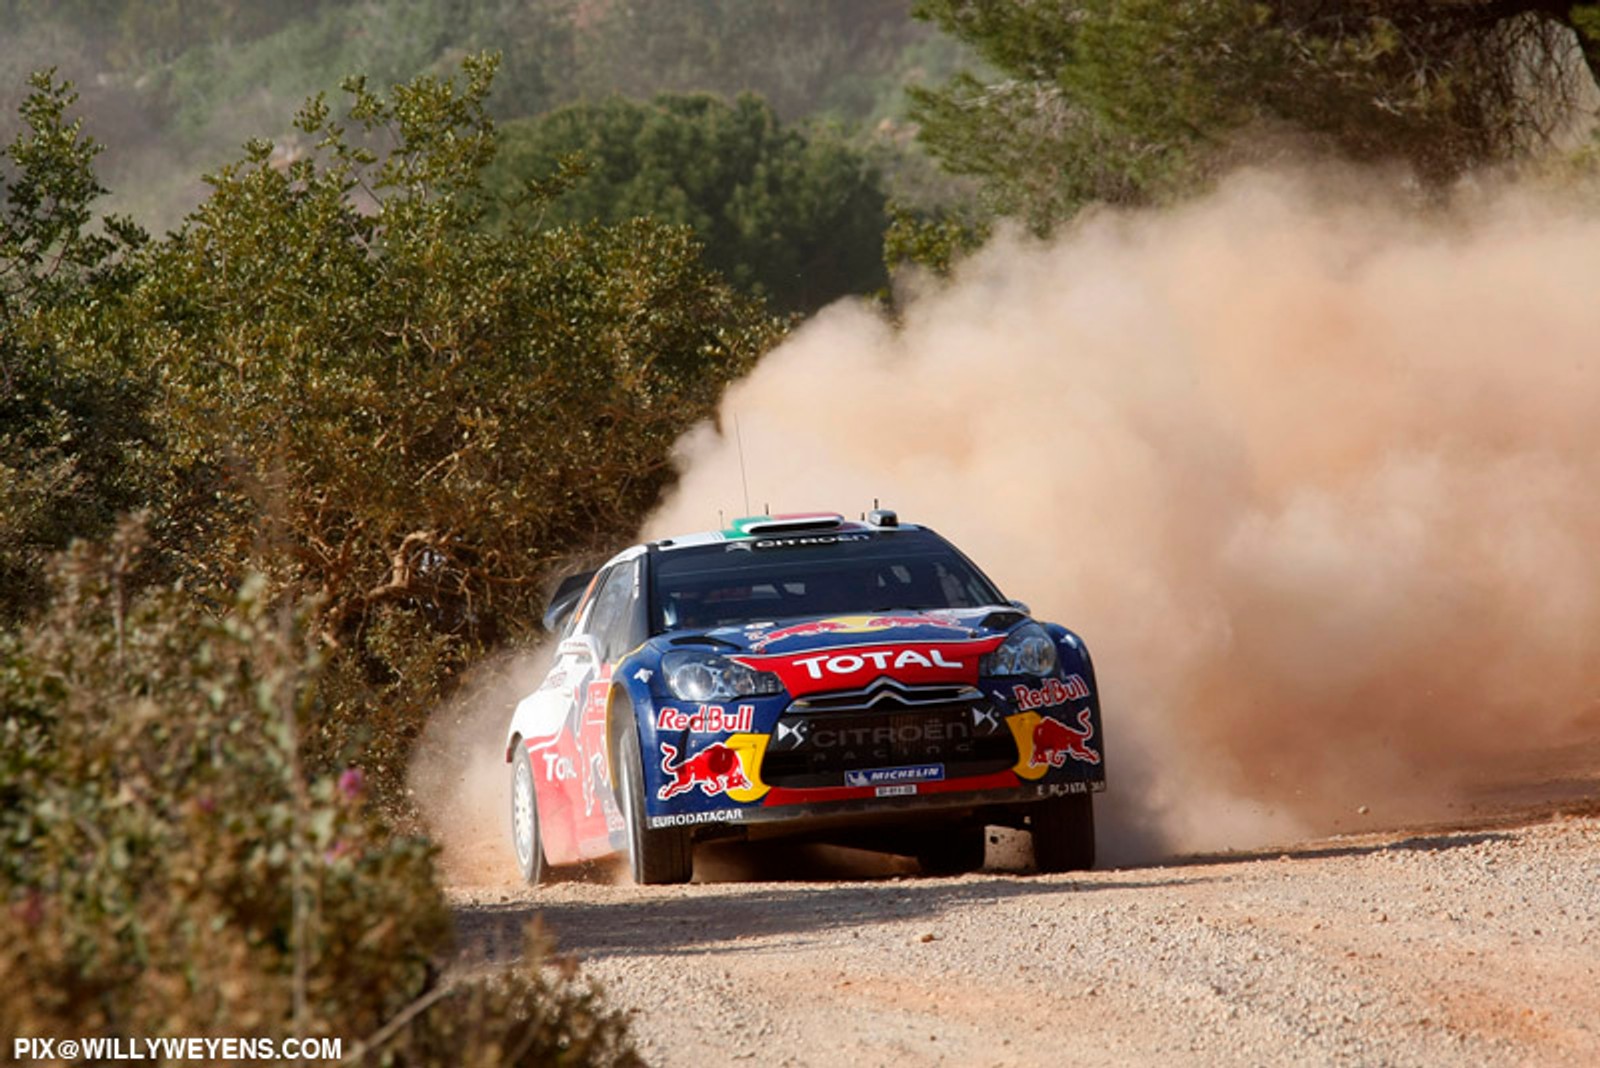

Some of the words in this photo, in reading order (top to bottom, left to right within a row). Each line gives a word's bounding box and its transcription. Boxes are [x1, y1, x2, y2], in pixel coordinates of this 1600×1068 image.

[792, 650, 963, 679] TOTAL
[1012, 678, 1051, 711] Red
[1050, 673, 1090, 705] Bull
[656, 705, 706, 733] Red
[706, 705, 755, 733] Bull
[871, 767, 939, 781] MICHELIN
[652, 808, 743, 828] EURODATACAR
